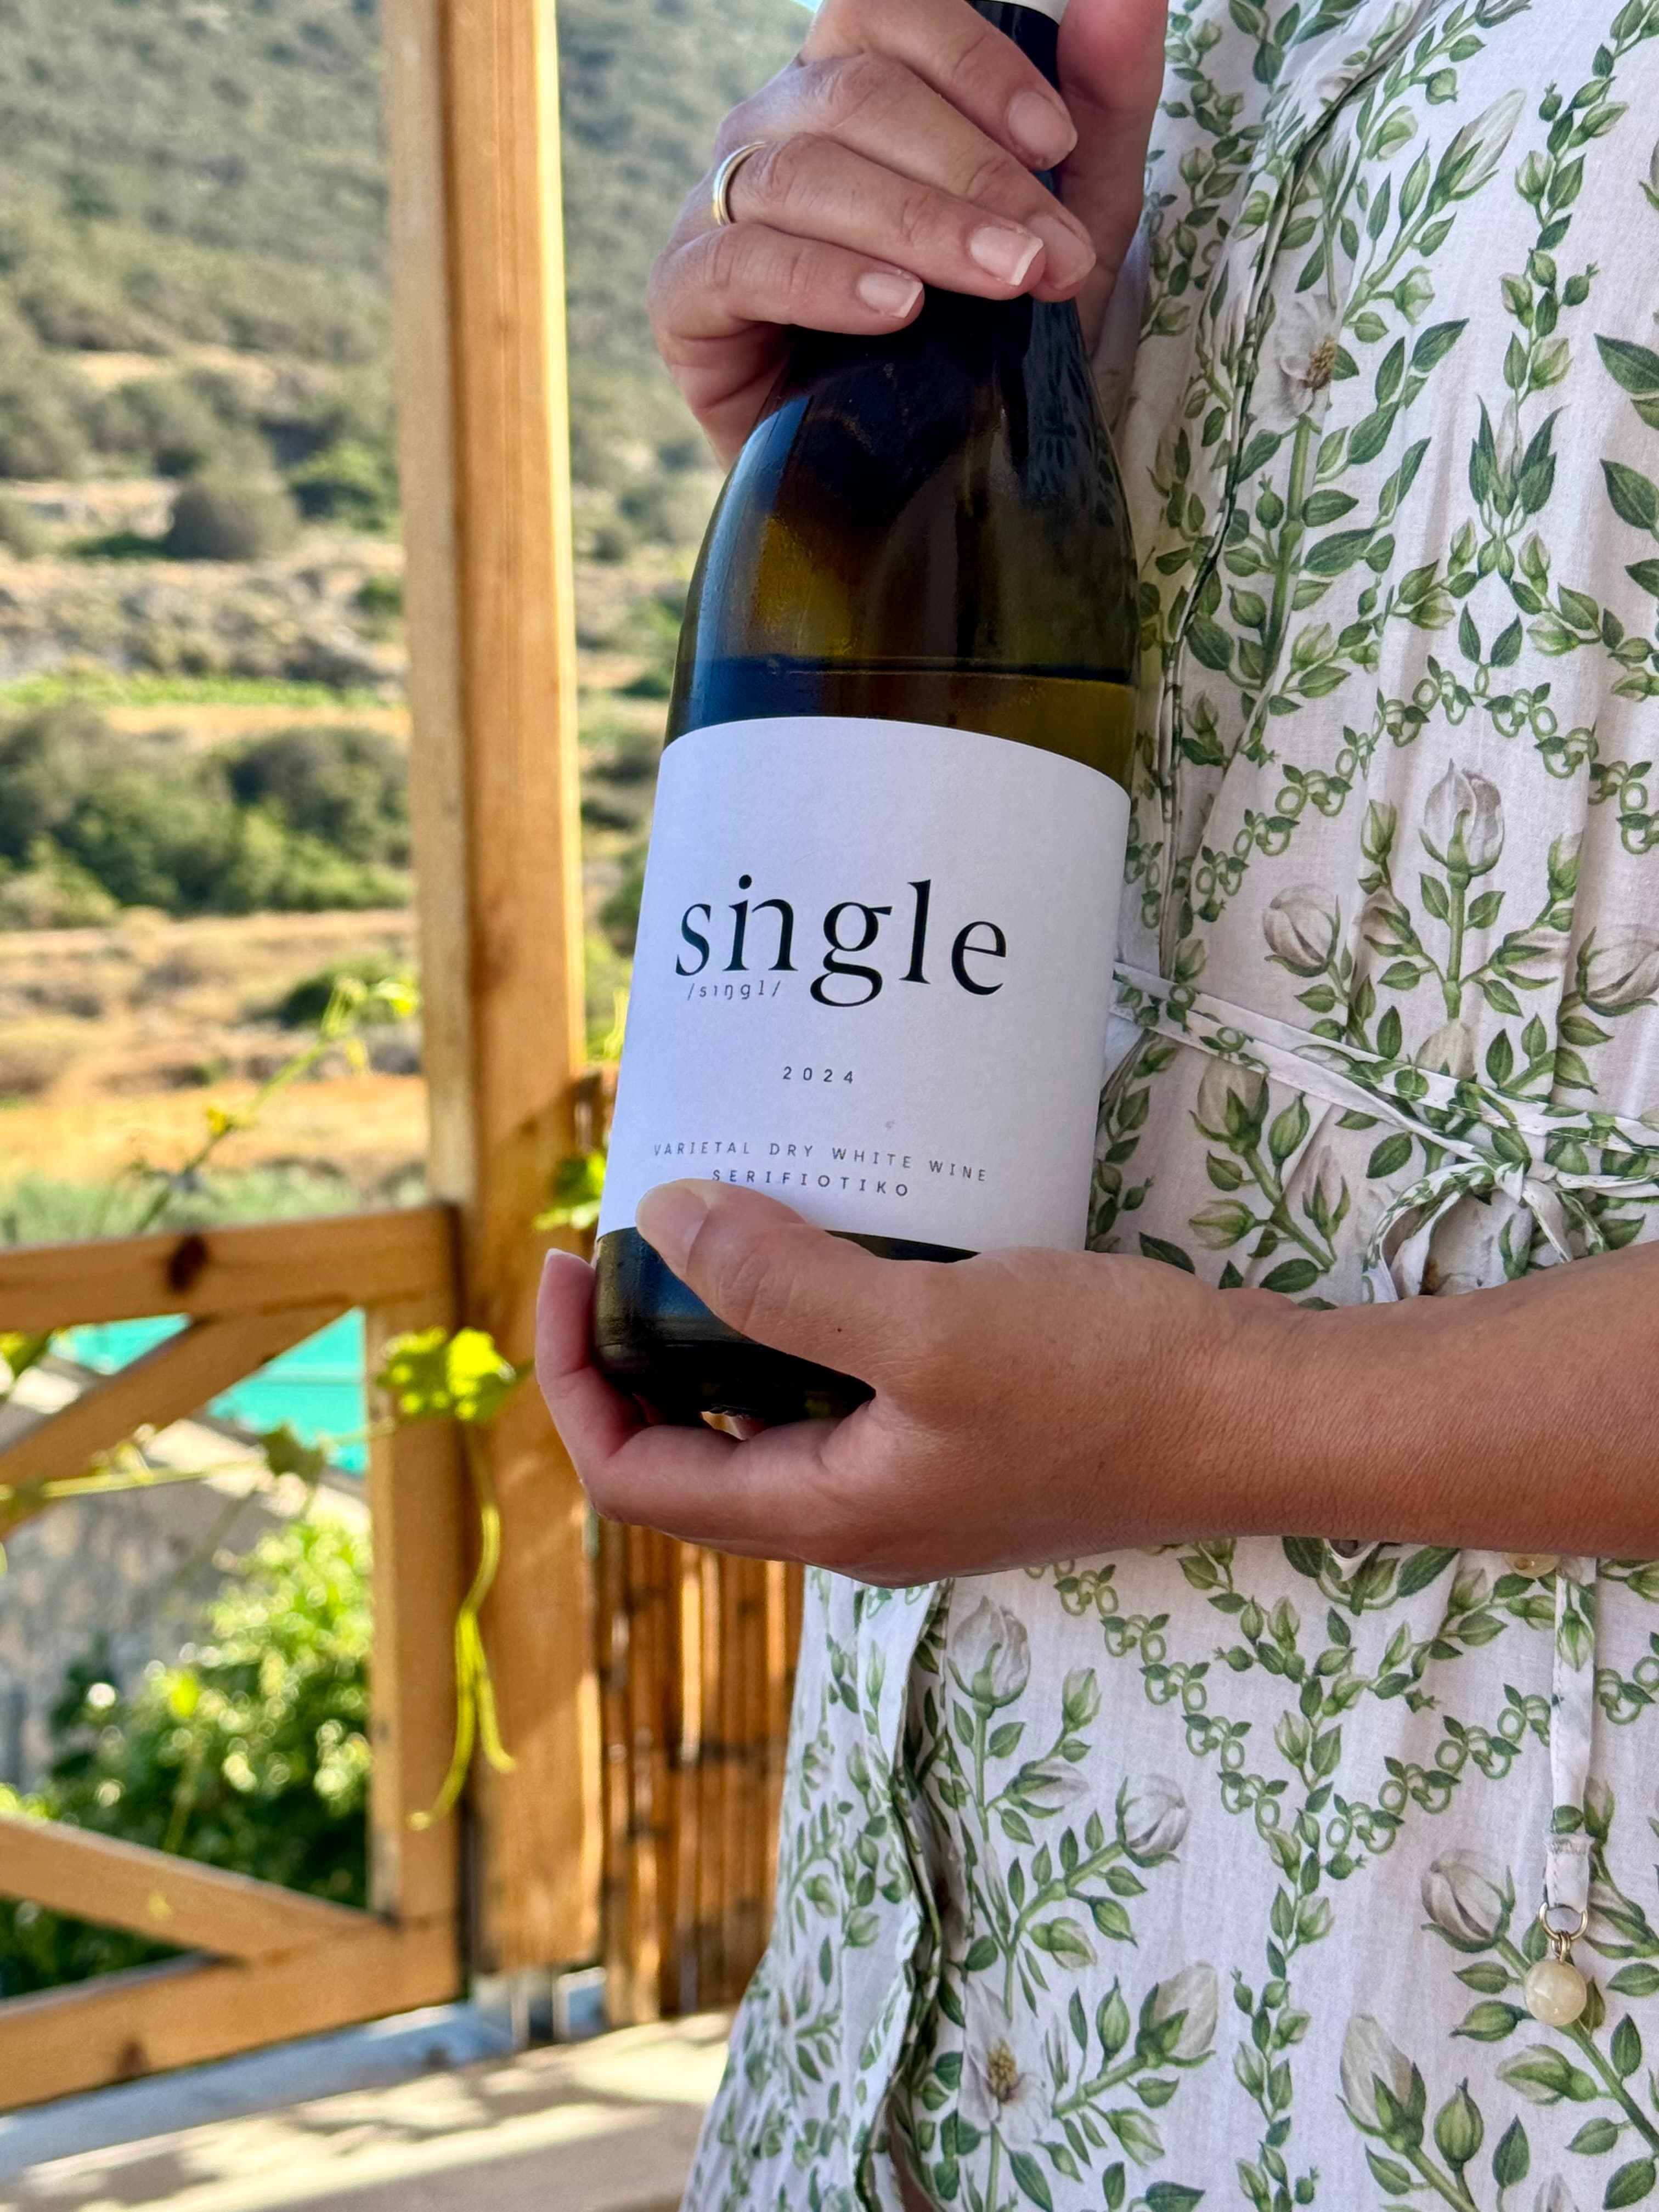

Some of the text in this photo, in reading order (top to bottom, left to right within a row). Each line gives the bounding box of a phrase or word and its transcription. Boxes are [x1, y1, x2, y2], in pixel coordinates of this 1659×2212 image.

[675, 874, 1006, 1007] single
[783, 1066, 853, 1084] 2024
[654, 1142, 986, 1182] VARIETAL DRY WHITE WINE
[713, 1170, 908, 1197] SERIFIOTIKO
